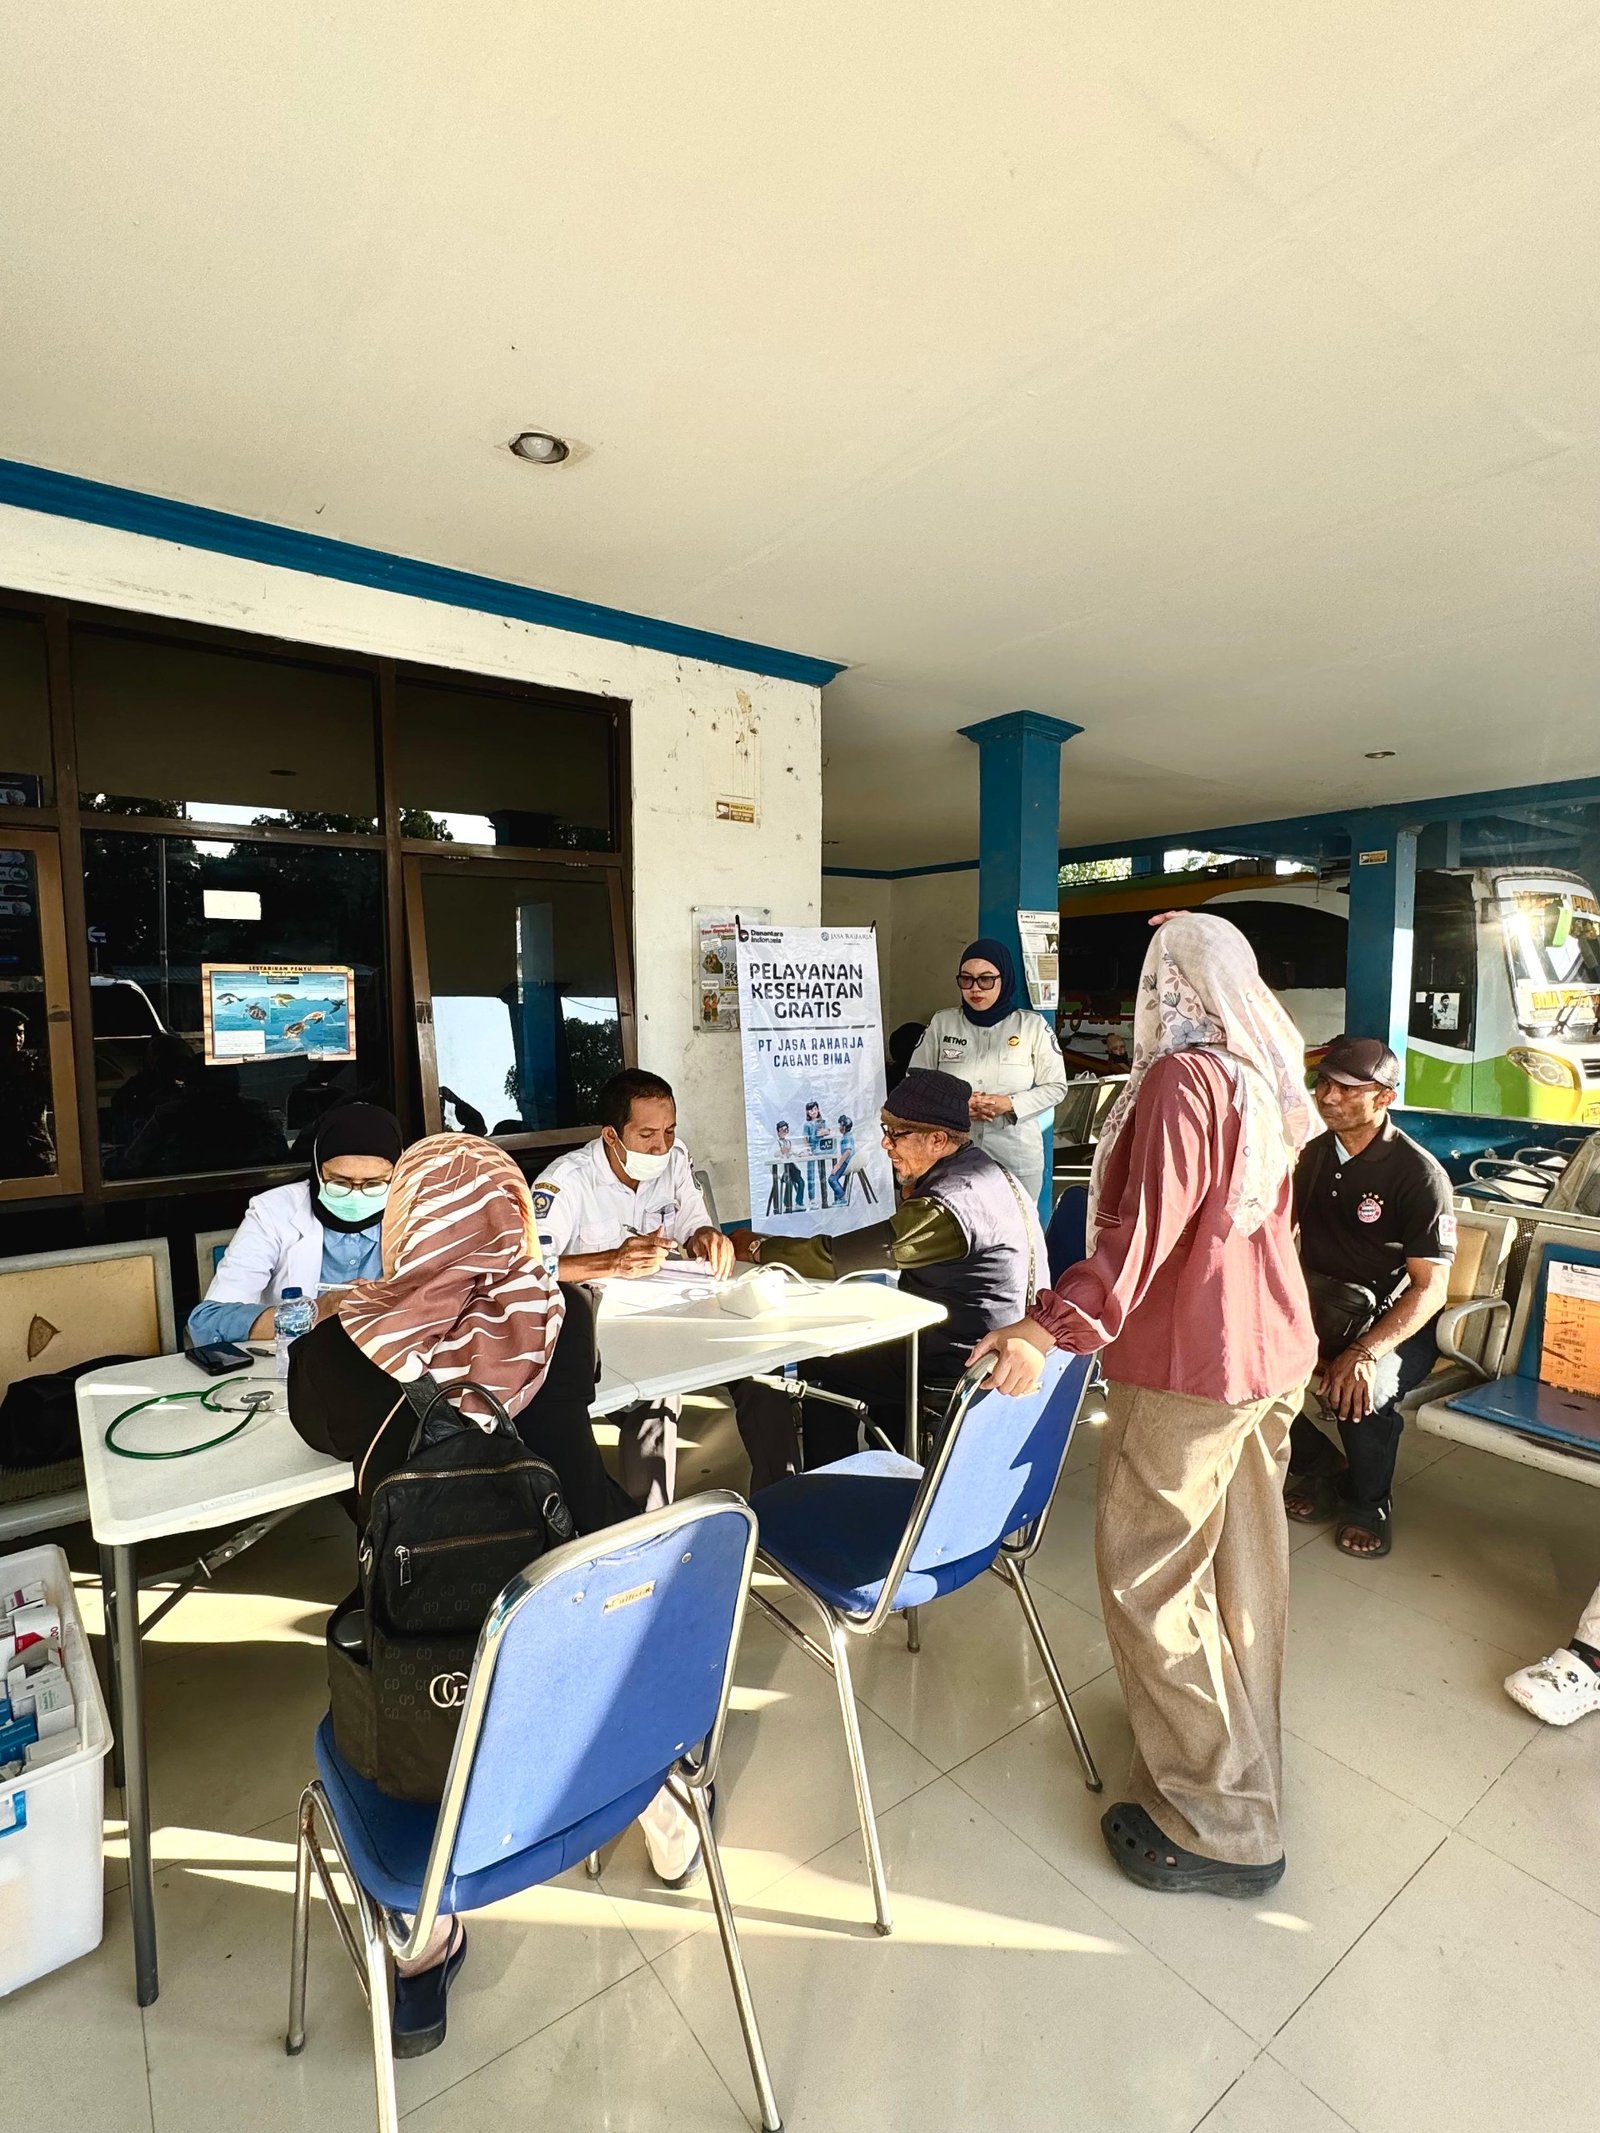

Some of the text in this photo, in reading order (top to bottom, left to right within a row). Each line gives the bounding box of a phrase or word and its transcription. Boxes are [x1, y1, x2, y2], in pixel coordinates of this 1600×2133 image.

[750, 929, 784, 937] Danantara
[749, 963, 863, 980] PELAYANAN
[751, 983, 863, 999] KESEHATAN
[774, 1001, 842, 1018] GRATIS
[758, 1036, 864, 1052] PT JASA RAHARJA
[943, 1035, 967, 1046] RETNO
[773, 1052, 851, 1067] CABANG BIMA
